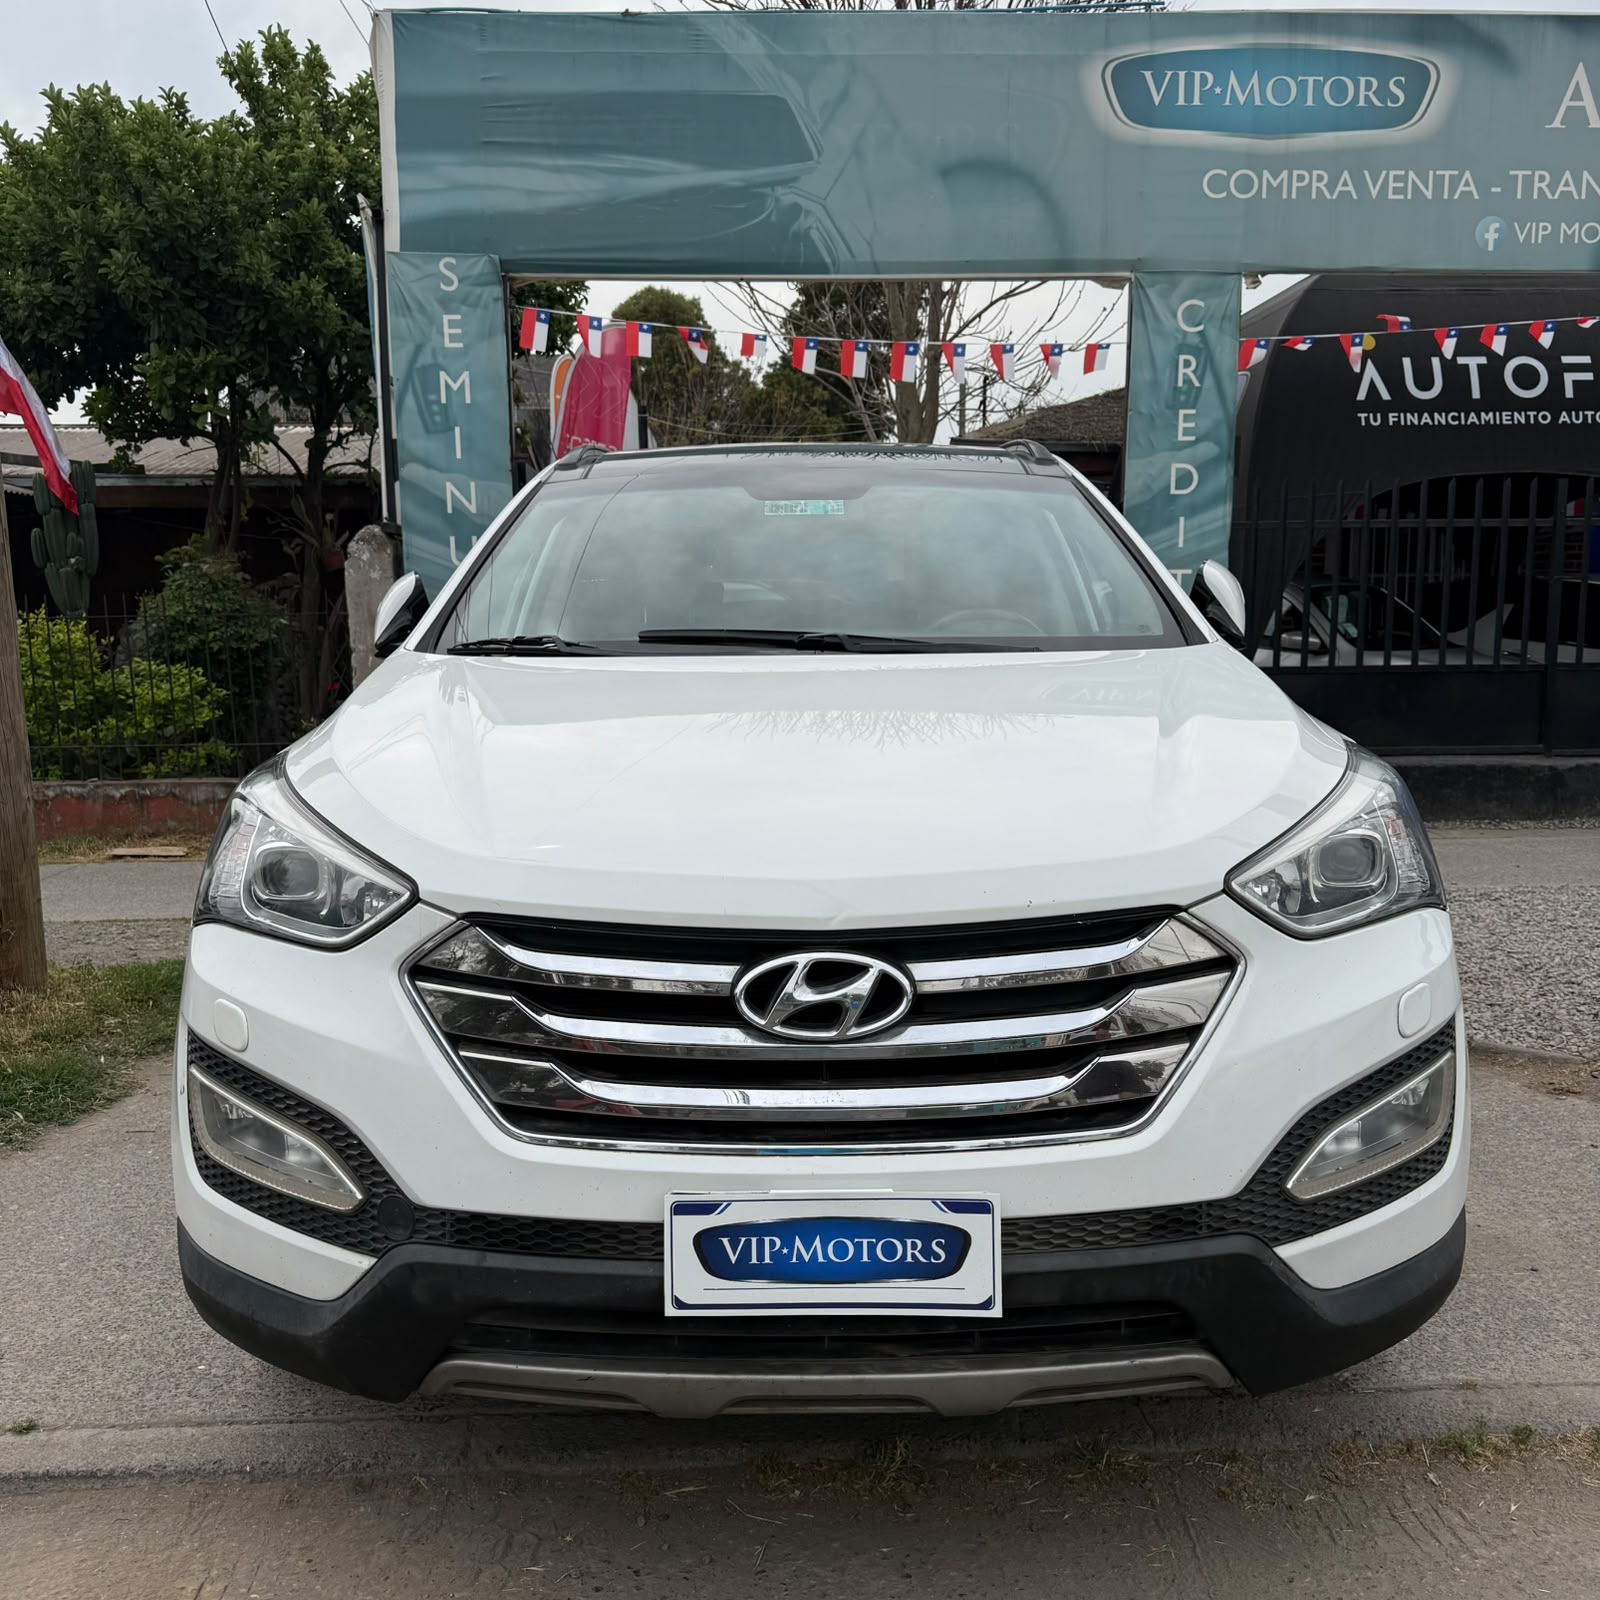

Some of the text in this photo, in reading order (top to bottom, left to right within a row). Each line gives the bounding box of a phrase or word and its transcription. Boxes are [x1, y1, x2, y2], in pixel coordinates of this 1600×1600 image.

[1140, 69, 1406, 108] VIP MOTORS
[1544, 61, 1600, 129] A
[1202, 168, 1358, 200] COMPRA
[1364, 169, 1479, 200] VENTA
[1509, 169, 1600, 200] TRAN
[1513, 221, 1552, 245] VIP
[1559, 221, 1600, 245] MO
[1356, 354, 1594, 400] AUTOF
[1357, 412, 1382, 427] TU
[1388, 410, 1552, 426] FINANCIAMIENTO
[718, 1233, 947, 1265] VIP MOTORS
